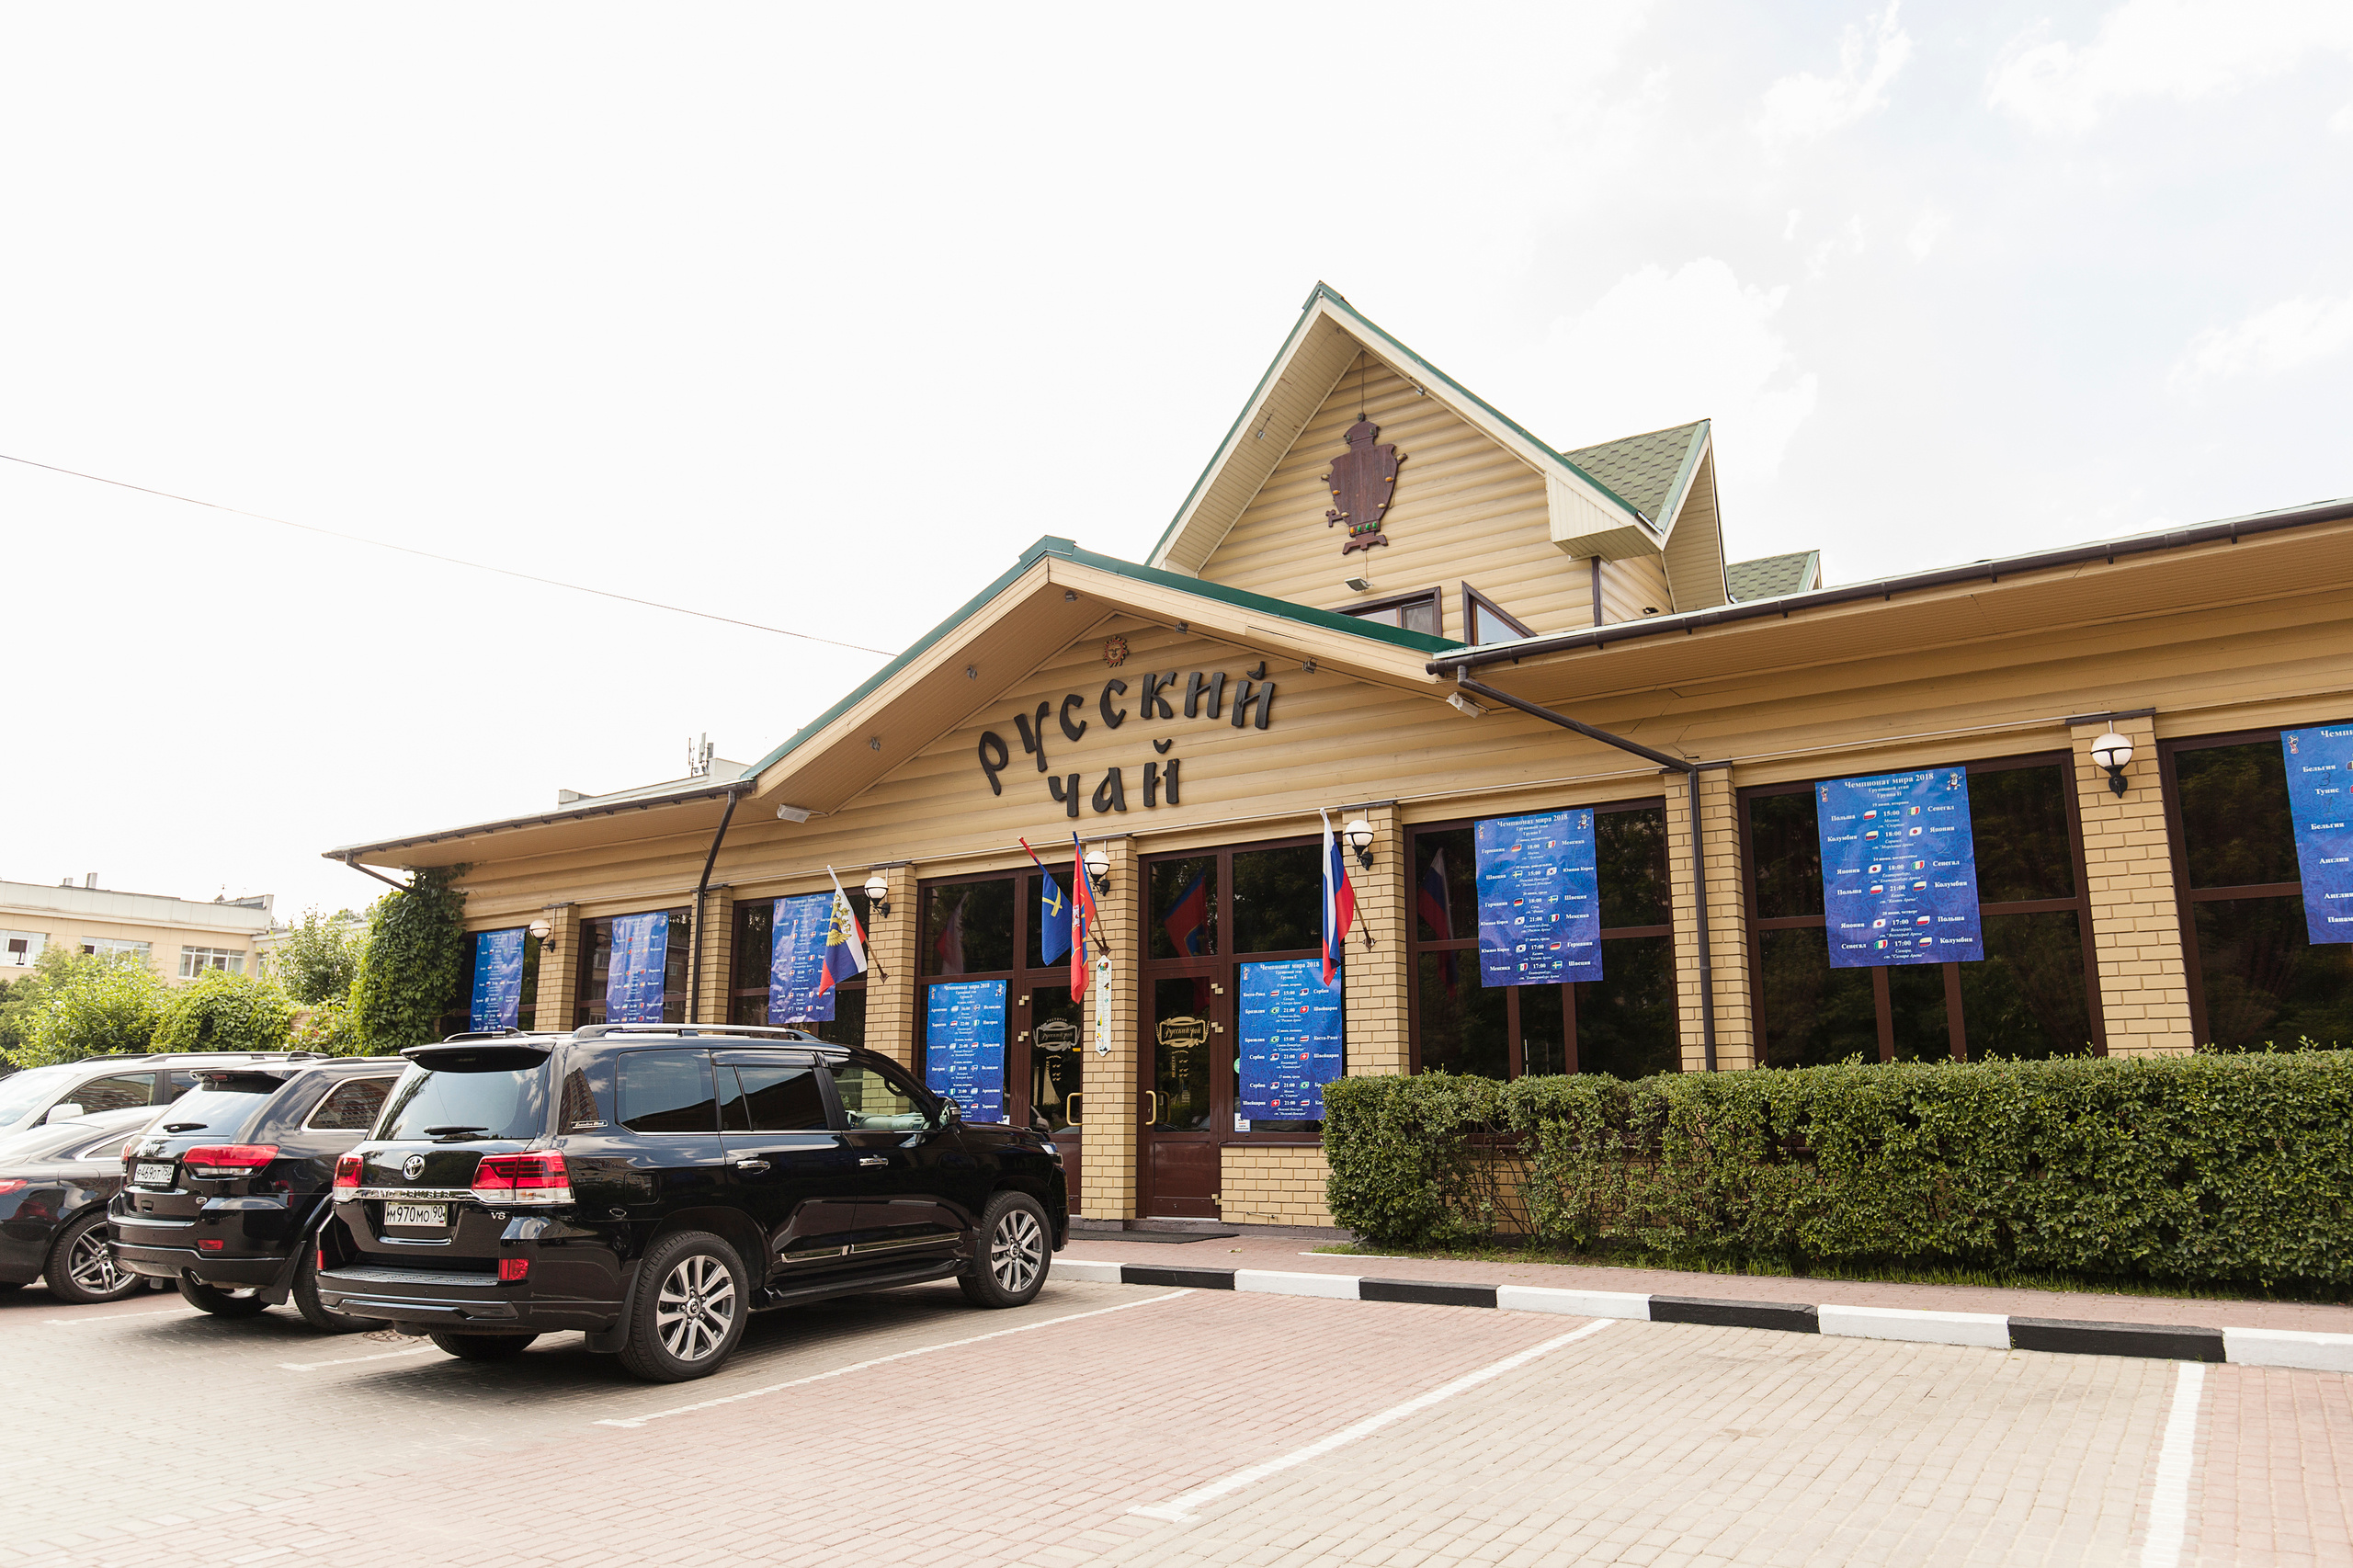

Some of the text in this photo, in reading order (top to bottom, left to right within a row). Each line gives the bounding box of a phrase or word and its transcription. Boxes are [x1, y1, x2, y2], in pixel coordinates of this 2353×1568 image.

[1845, 773, 1934, 788] Чемпионат мира 2018
[2318, 772, 2331, 786] 3
[1497, 819, 1533, 827] Чемпионат
[1938, 836, 1951, 854] 2
[1935, 881, 1967, 889] Колумбия
[433, 1206, 443, 1218] 90
